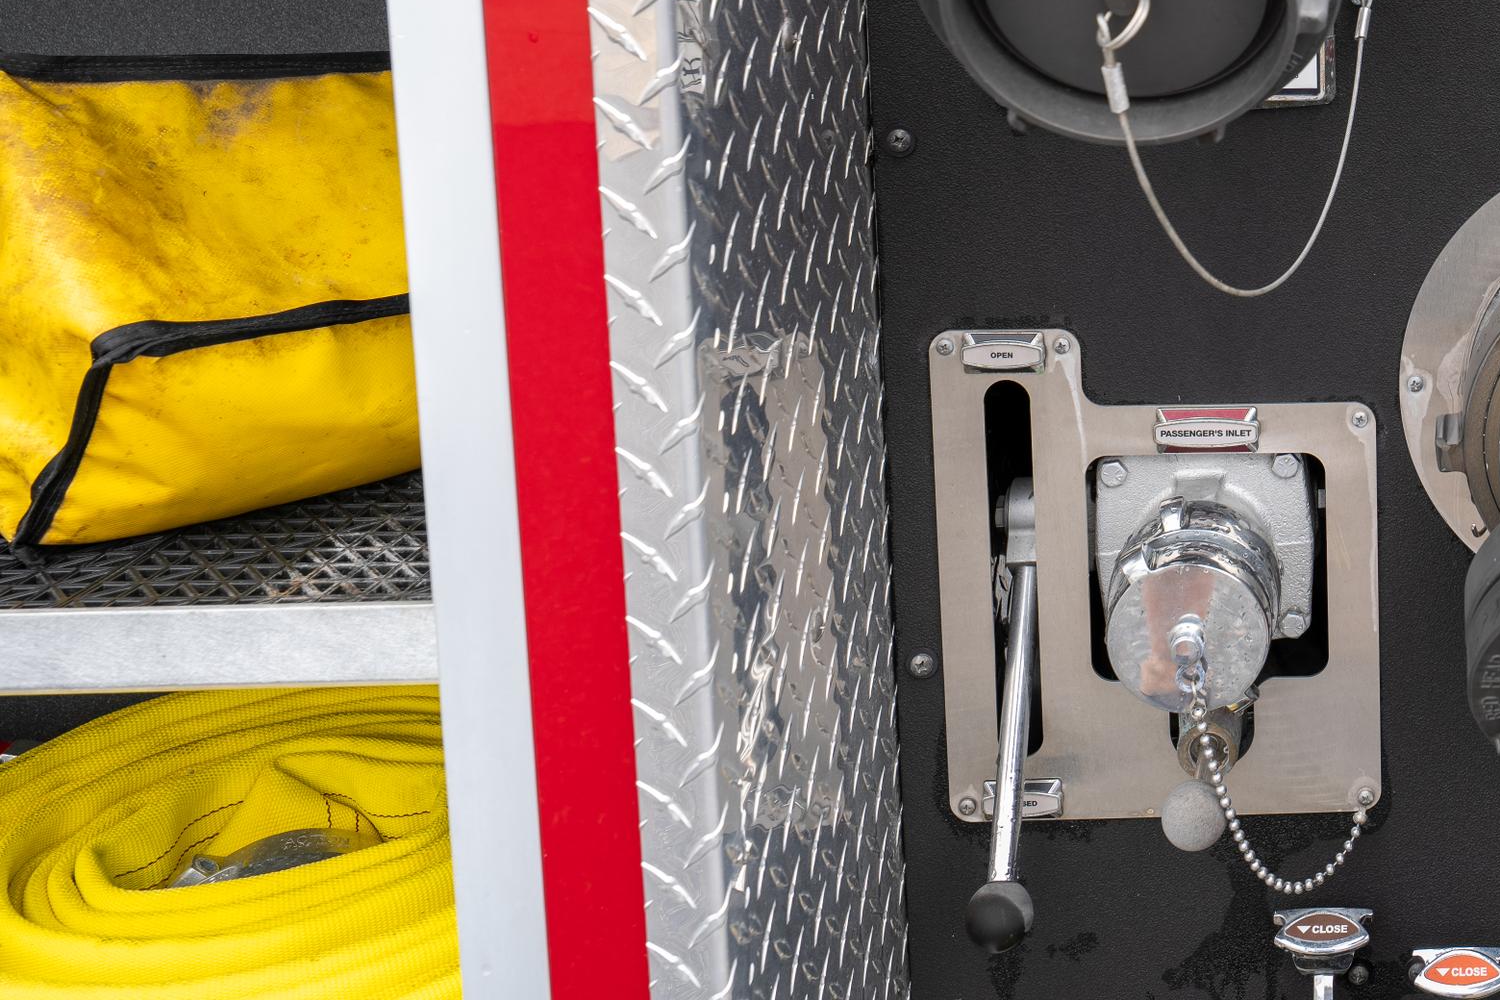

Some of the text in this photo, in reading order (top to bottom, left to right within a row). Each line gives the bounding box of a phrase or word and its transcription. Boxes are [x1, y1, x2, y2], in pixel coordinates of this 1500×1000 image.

[1160, 429, 1252, 438] PASSENGER'S INLET
[1312, 924, 1348, 933] CLOSE
[1451, 967, 1488, 977] CLOSE
